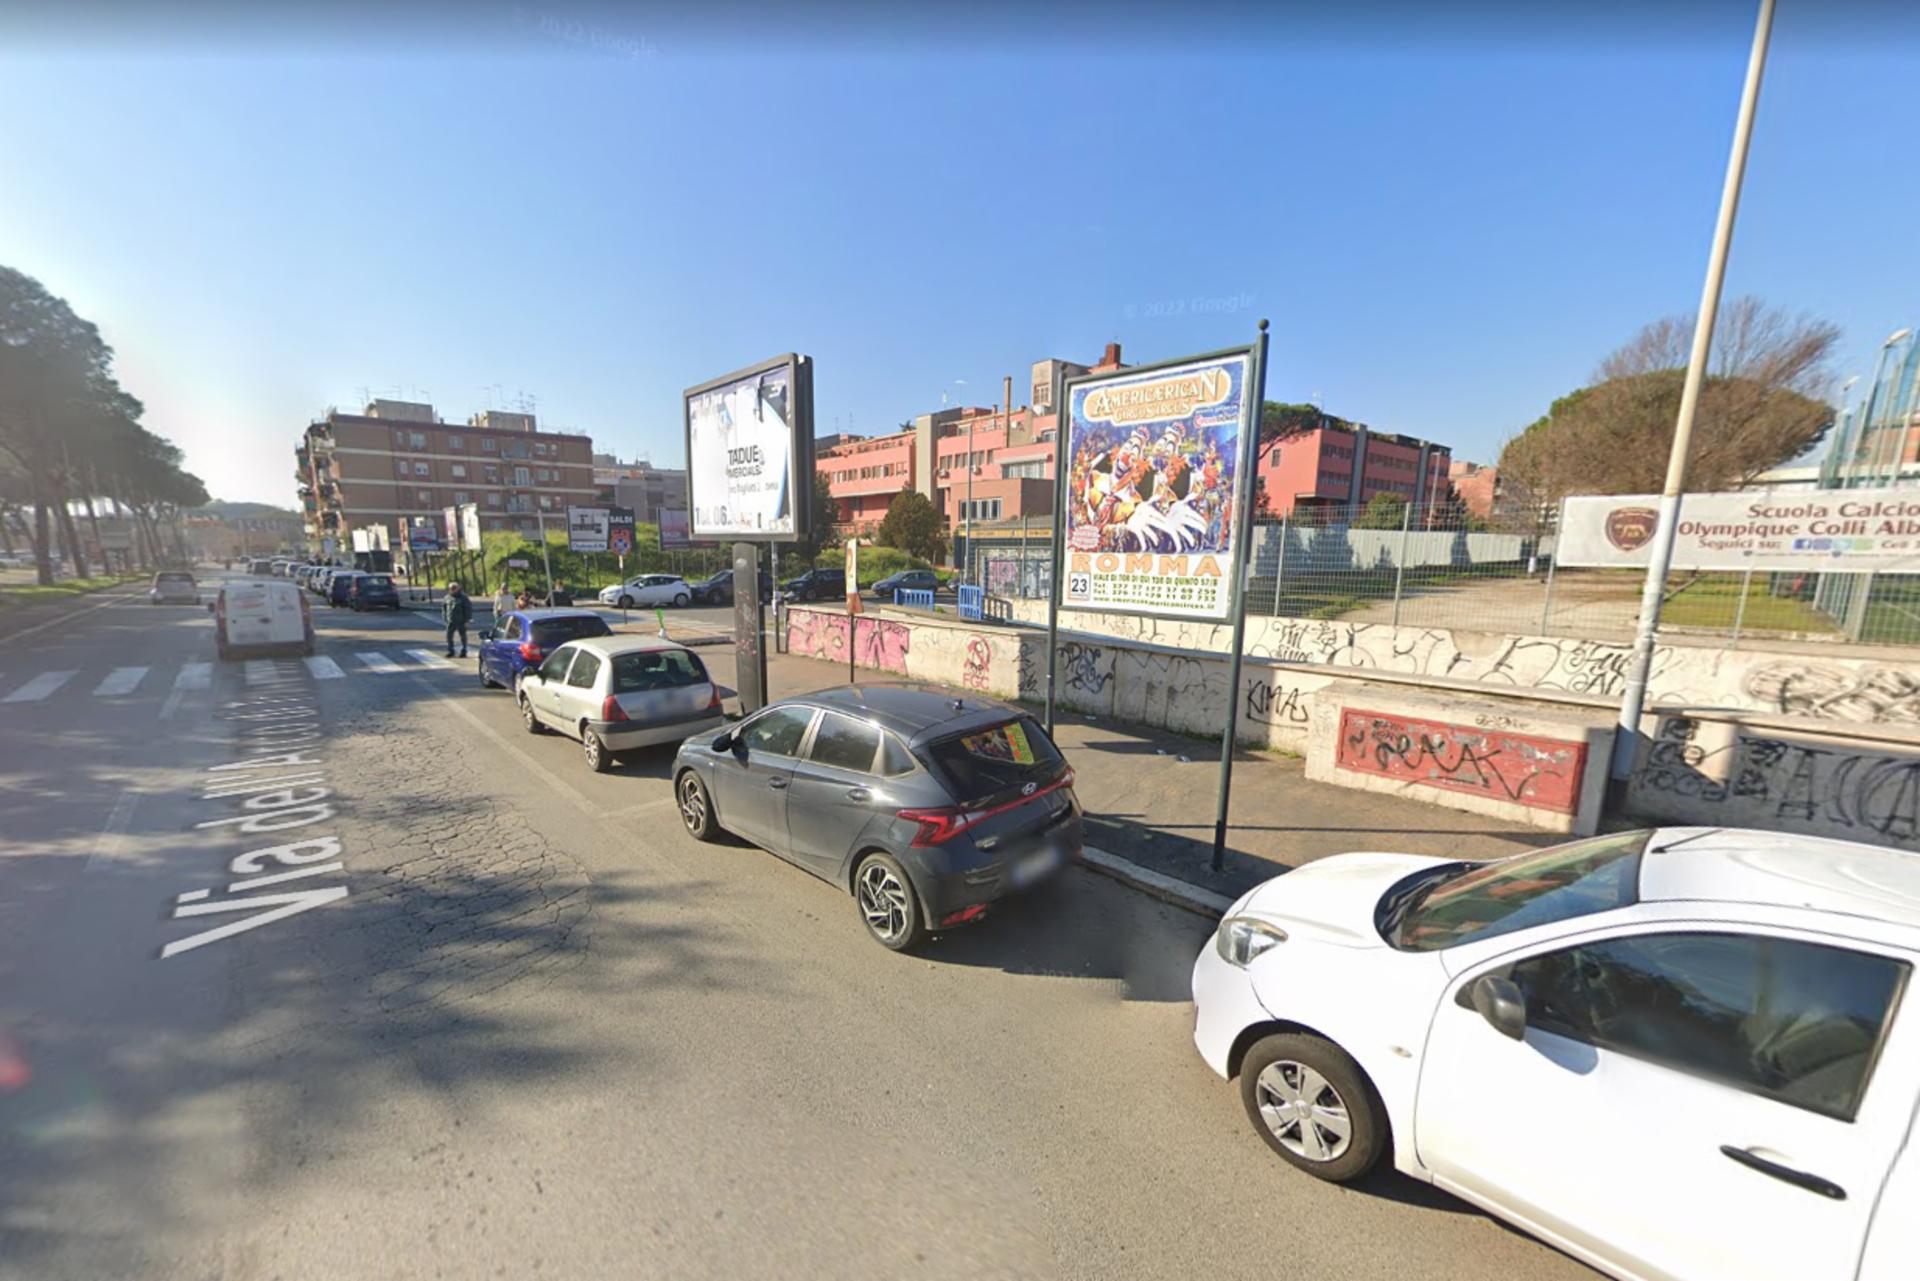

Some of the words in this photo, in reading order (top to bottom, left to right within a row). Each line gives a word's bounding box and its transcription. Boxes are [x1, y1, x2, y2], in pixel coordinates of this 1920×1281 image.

[1747, 503, 1829, 519] Scuola
[1837, 502, 1920, 518] Calcio
[1678, 521, 1800, 538] Olympique
[1808, 519, 1866, 536] Colli
[1071, 553, 1223, 577] ROMMA
[1071, 578, 1088, 593] 23
